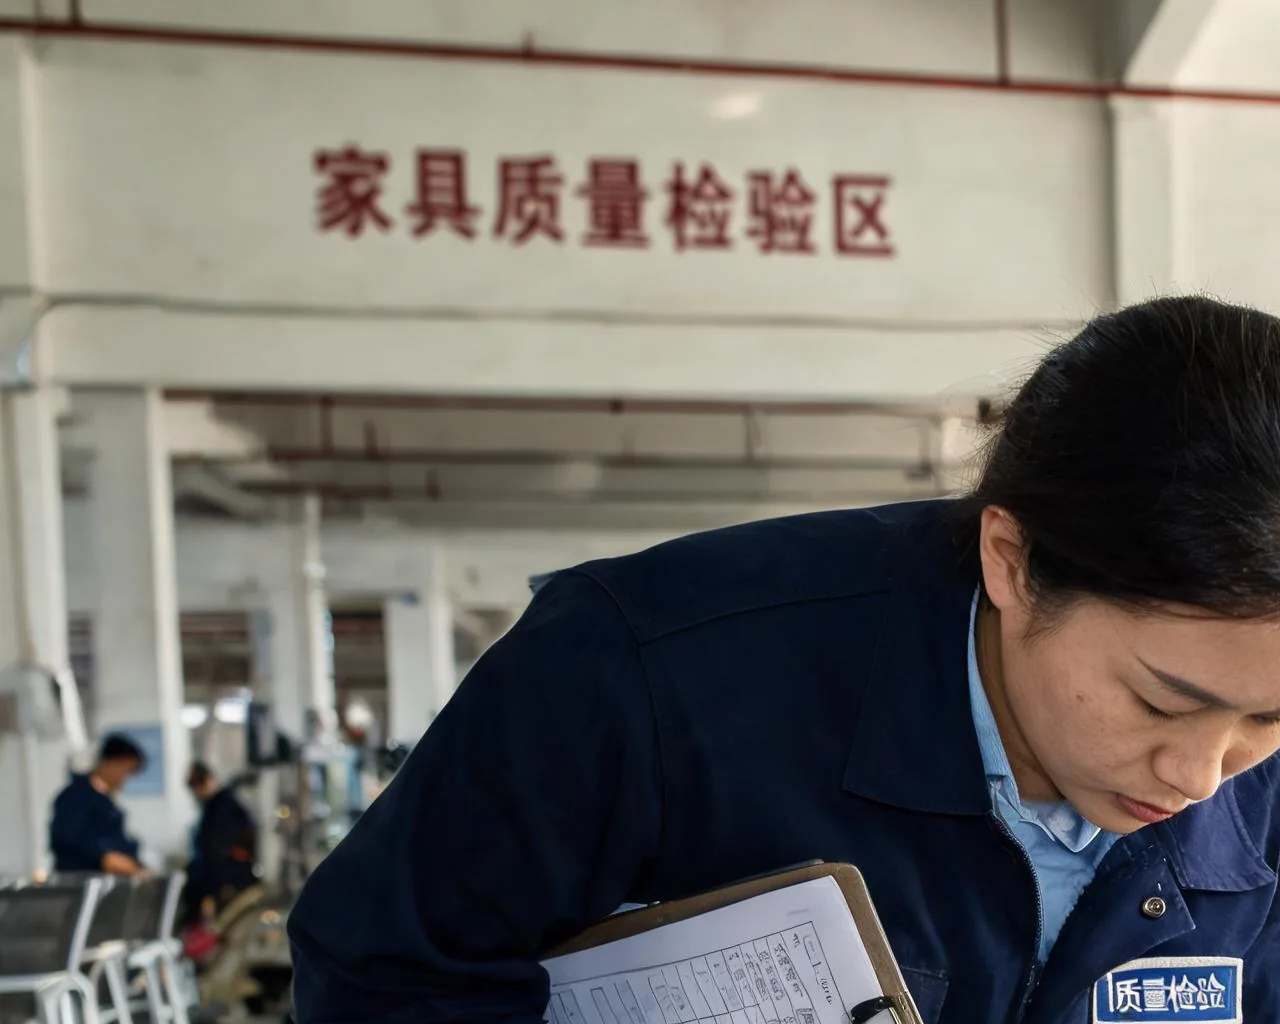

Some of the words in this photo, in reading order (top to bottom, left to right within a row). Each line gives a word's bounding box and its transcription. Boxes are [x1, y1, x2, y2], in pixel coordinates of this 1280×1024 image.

[312, 144, 895, 258] 家具质量检验区
